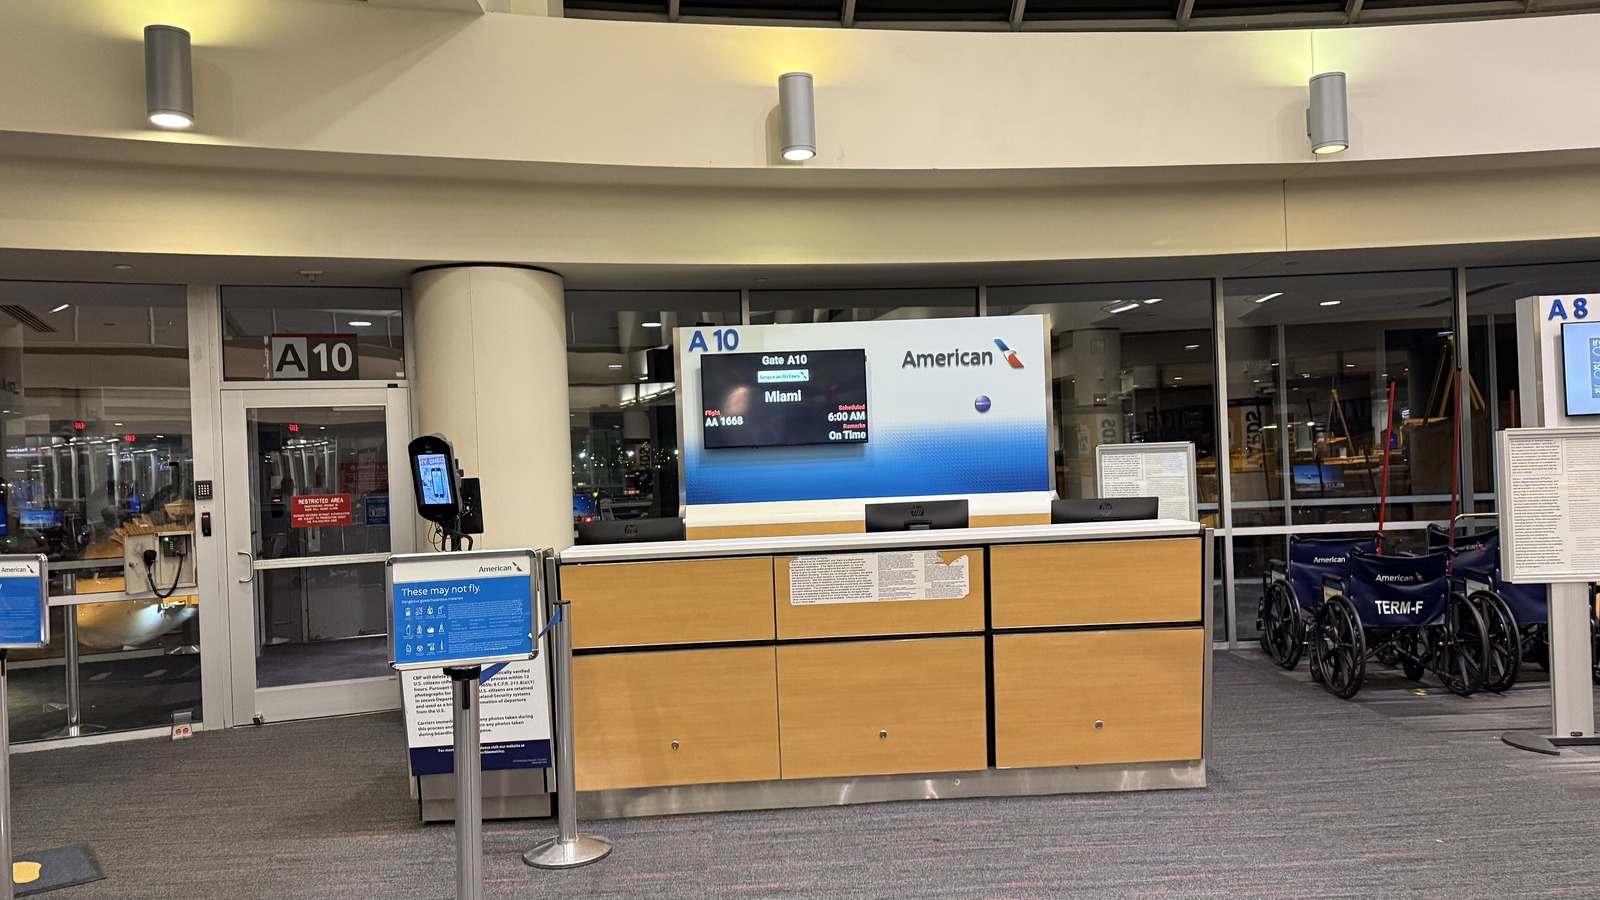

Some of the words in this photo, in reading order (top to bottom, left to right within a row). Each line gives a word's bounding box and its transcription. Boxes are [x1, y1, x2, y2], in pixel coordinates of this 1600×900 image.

[1548, 299, 1568, 320] A
[1573, 298, 1588, 319] 8
[689, 330, 708, 352] A
[713, 329, 739, 351] 10
[275, 344, 305, 372] A
[312, 343, 352, 372] 10
[761, 355, 784, 366] Gate
[786, 354, 807, 365] A10
[901, 348, 993, 369] American
[765, 389, 802, 403] Miami
[705, 417, 719, 427] AA
[720, 416, 744, 426] 1668
[828, 411, 848, 422] 6:00
[849, 411, 865, 421] AM
[828, 430, 842, 440] On
[842, 430, 866, 440] Time
[1313, 556, 1346, 564] American
[478, 565, 512, 573] American
[1375, 574, 1414, 582] American
[401, 588, 428, 597] These
[430, 587, 450, 596] may
[451, 585, 467, 593] not
[468, 583, 481, 594] fly.
[1374, 600, 1424, 615] TERM-F
